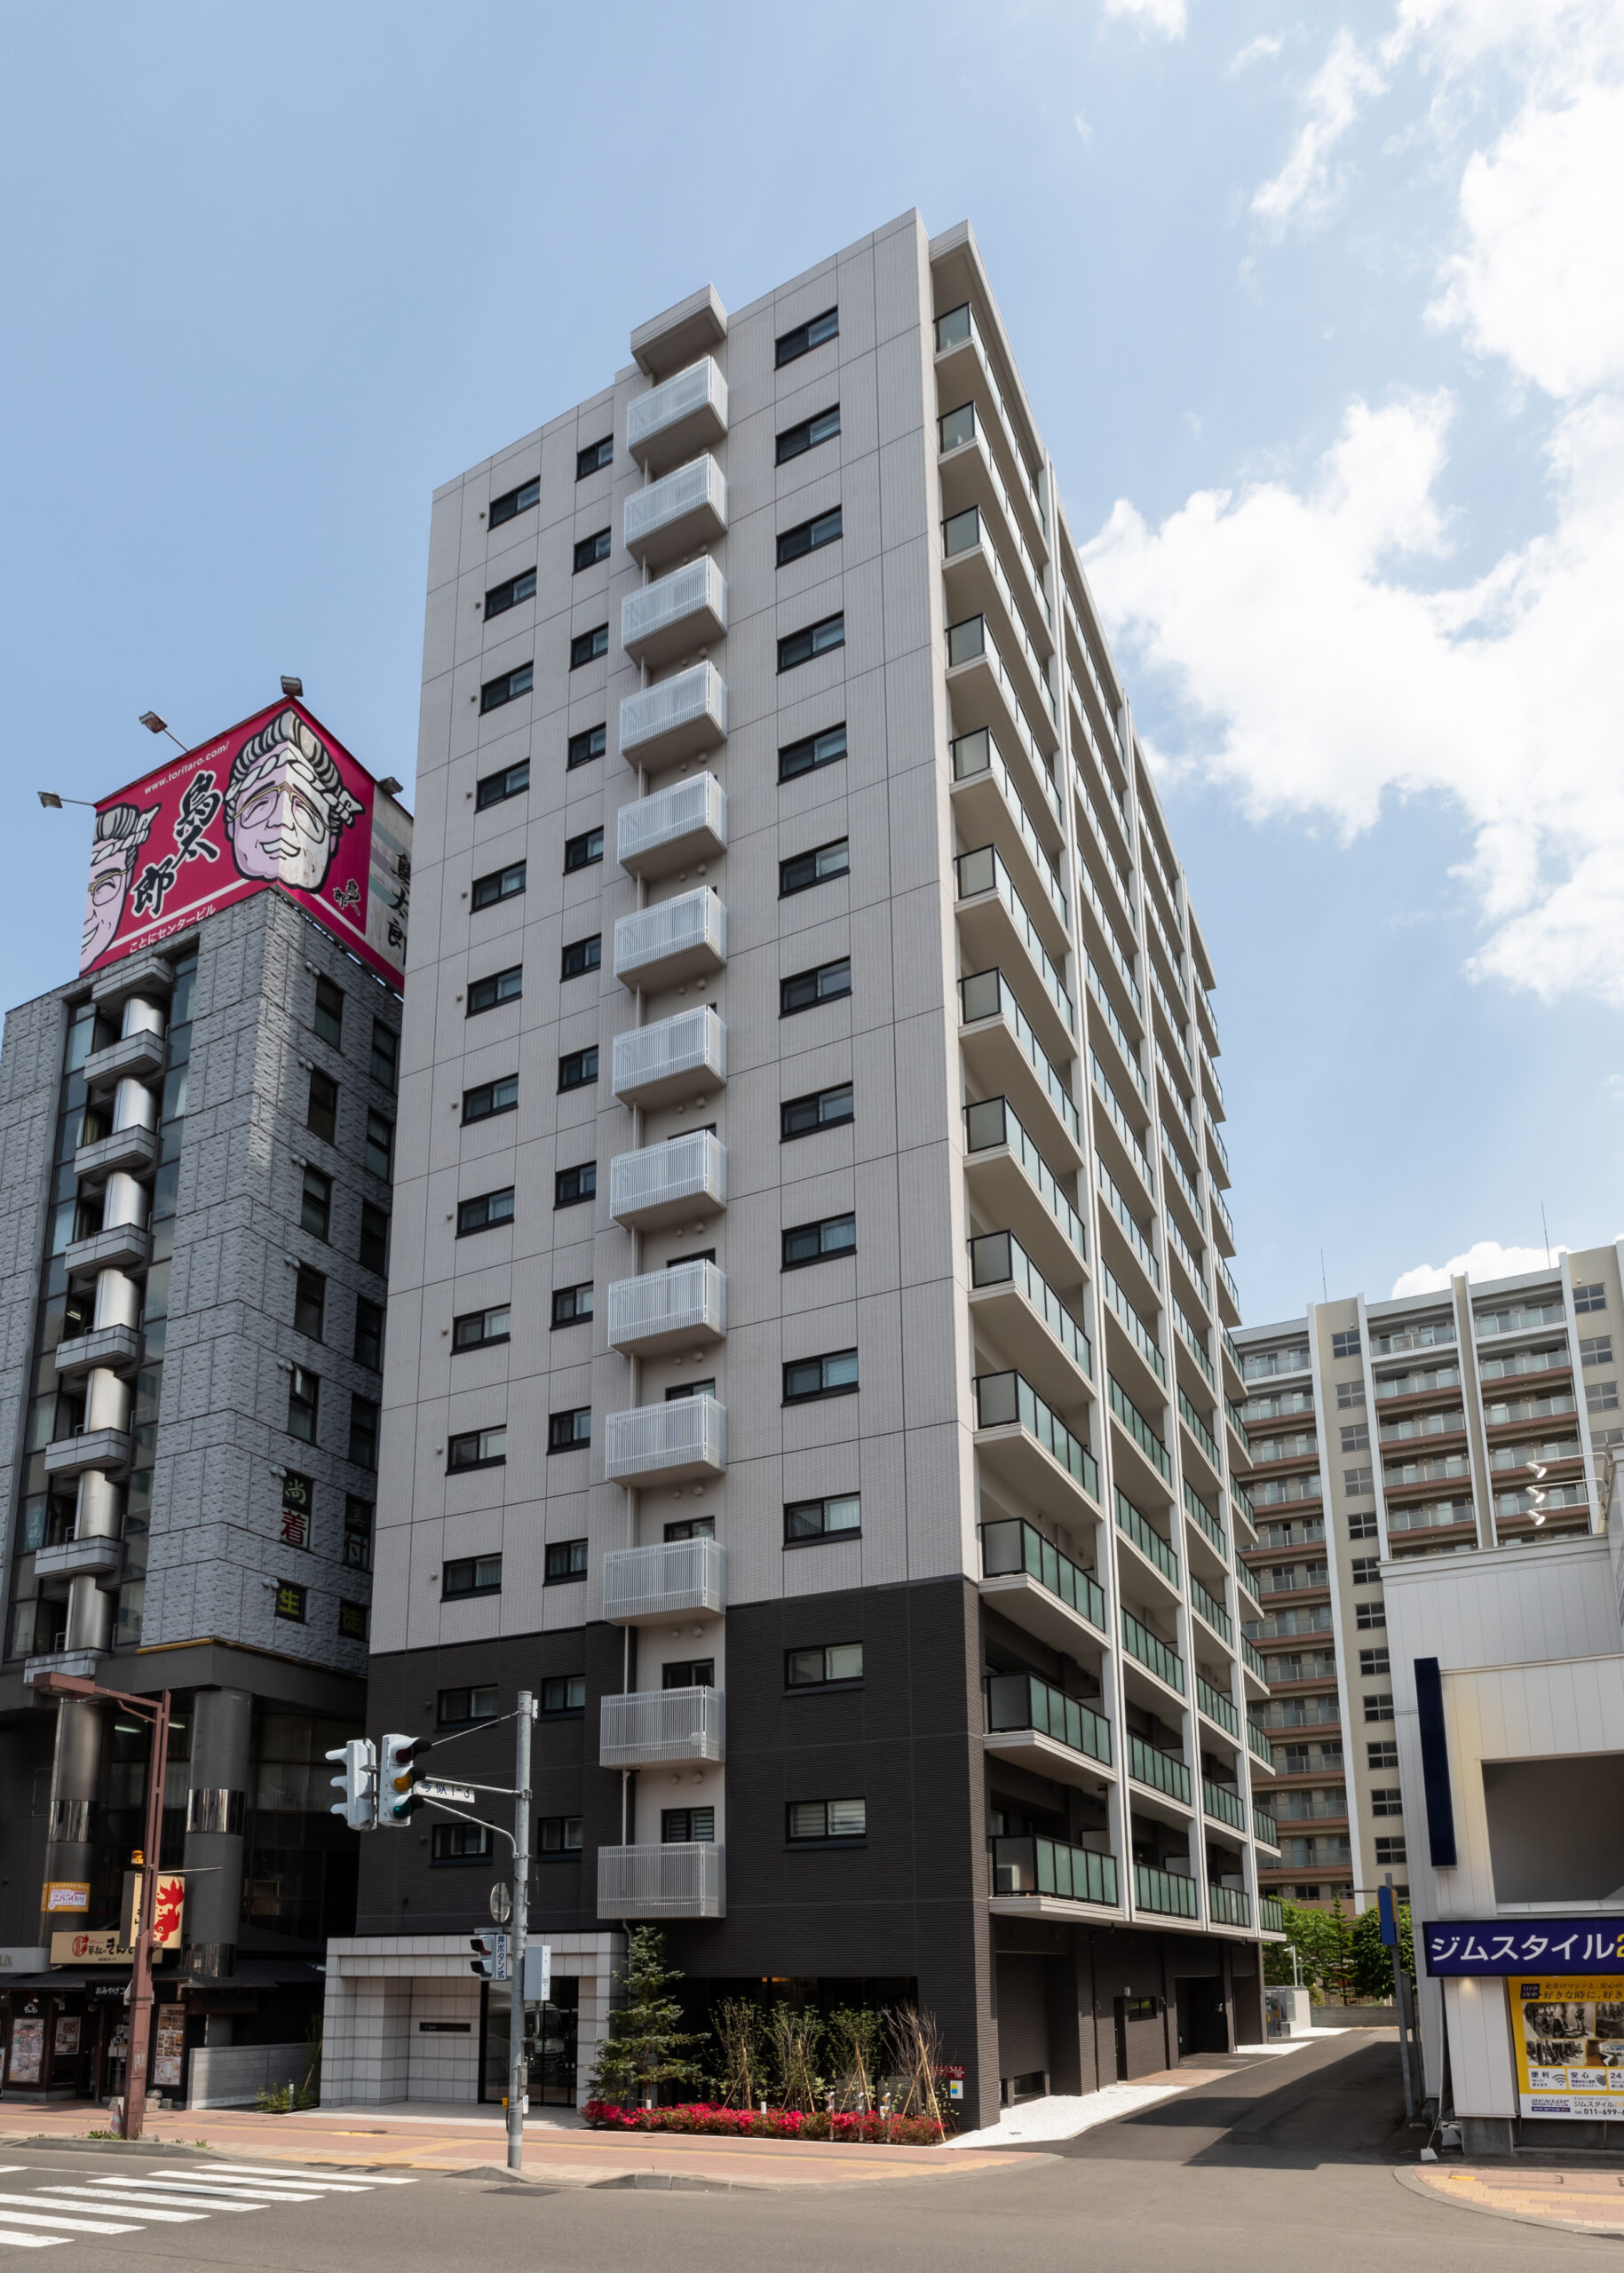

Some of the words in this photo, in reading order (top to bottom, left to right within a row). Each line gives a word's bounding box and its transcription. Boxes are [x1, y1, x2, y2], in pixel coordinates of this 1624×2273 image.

[144, 741, 231, 795] www.toritaro.com/
[130, 904, 217, 954] ことにセンタービル
